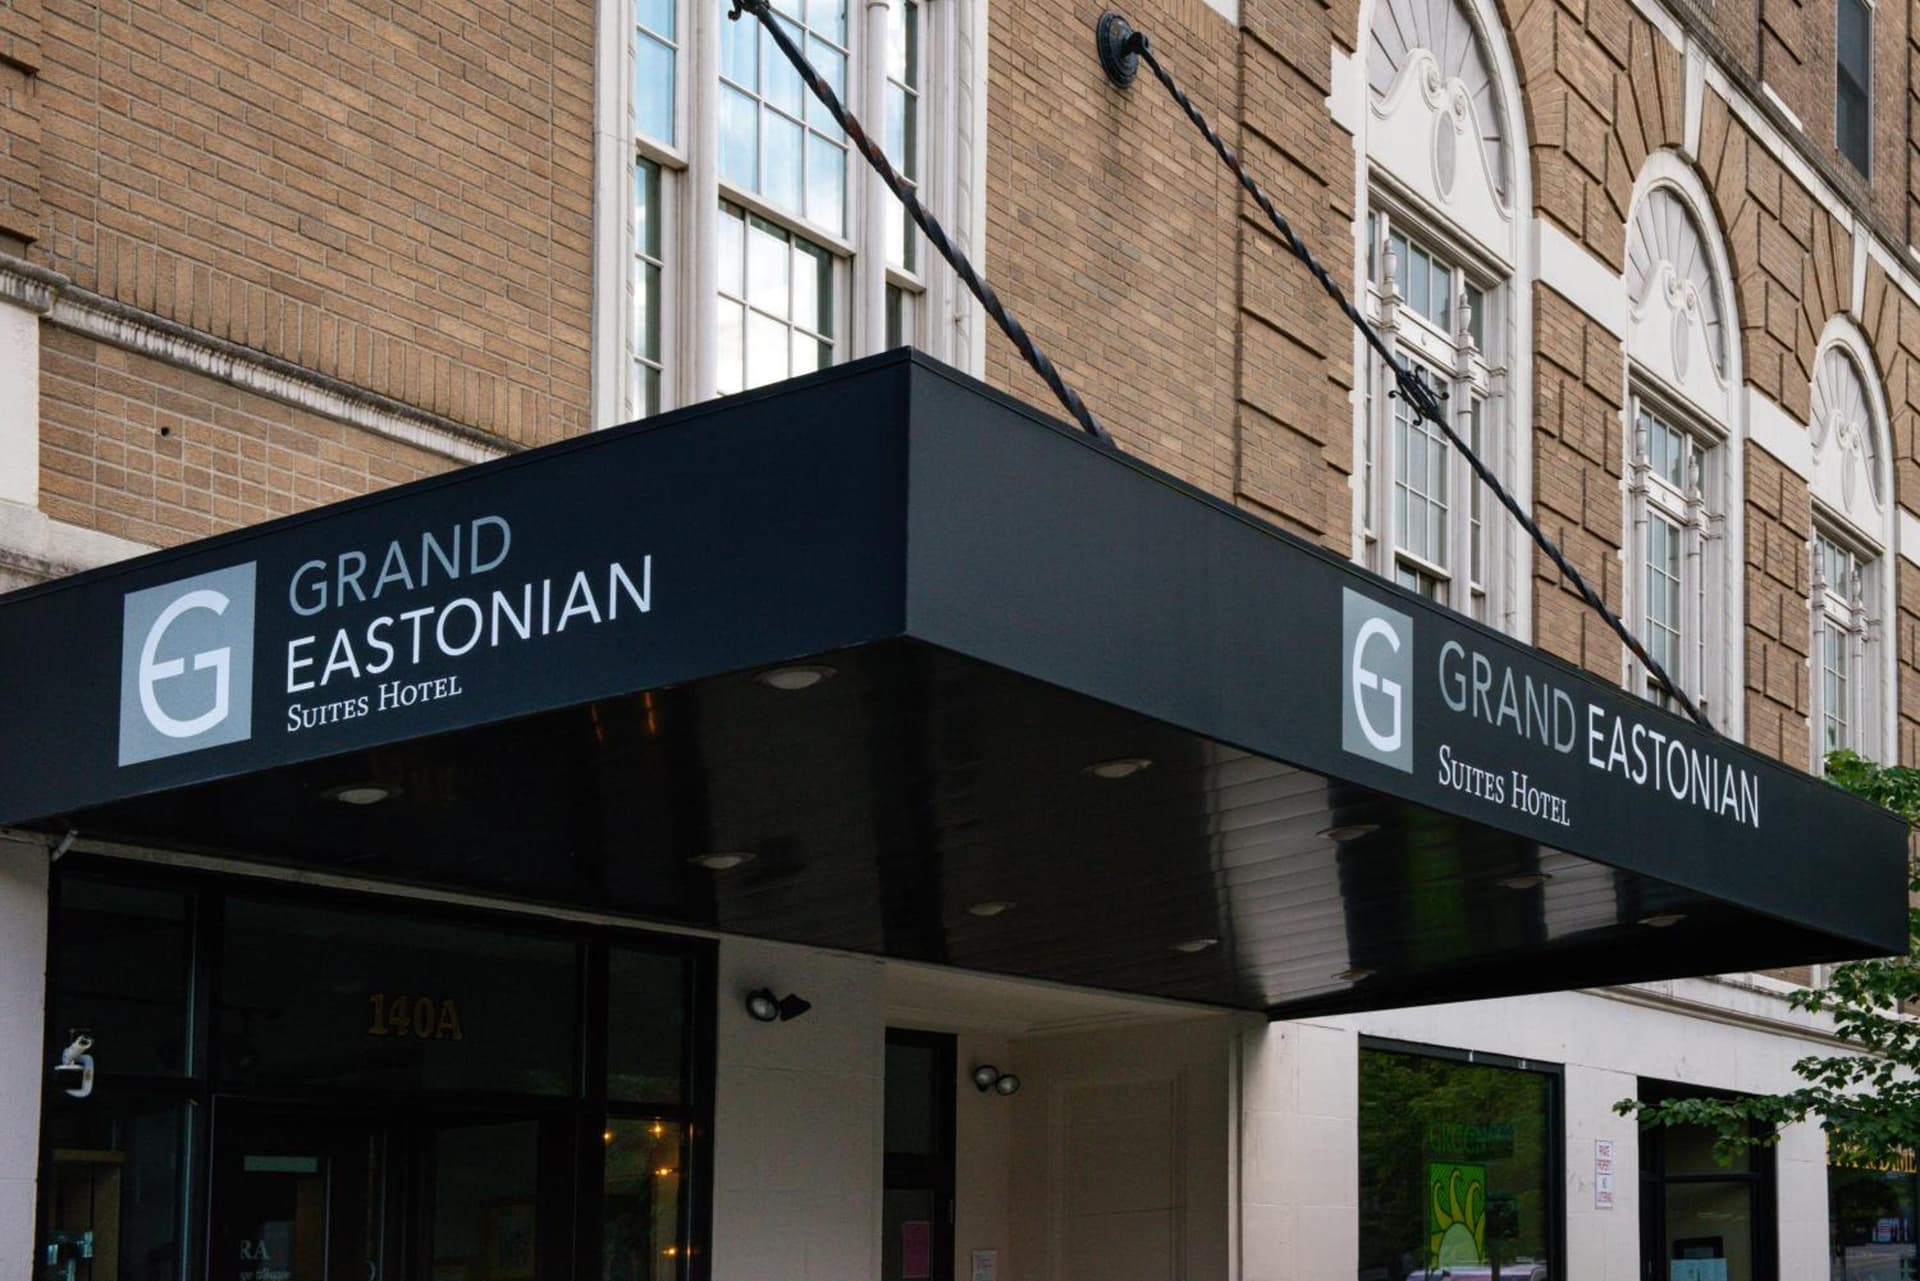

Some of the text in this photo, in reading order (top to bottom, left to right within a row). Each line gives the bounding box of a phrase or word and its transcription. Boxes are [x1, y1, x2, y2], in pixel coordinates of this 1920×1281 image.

[290, 516, 511, 615] GRAND
[287, 555, 652, 694] EASTONIAN
[287, 675, 463, 733] SUITES HOTEL
[1438, 640, 1759, 829] GRAND EASTONIAN
[1438, 744, 1571, 827] SUITES HOTEL
[368, 993, 463, 1040] 140A
